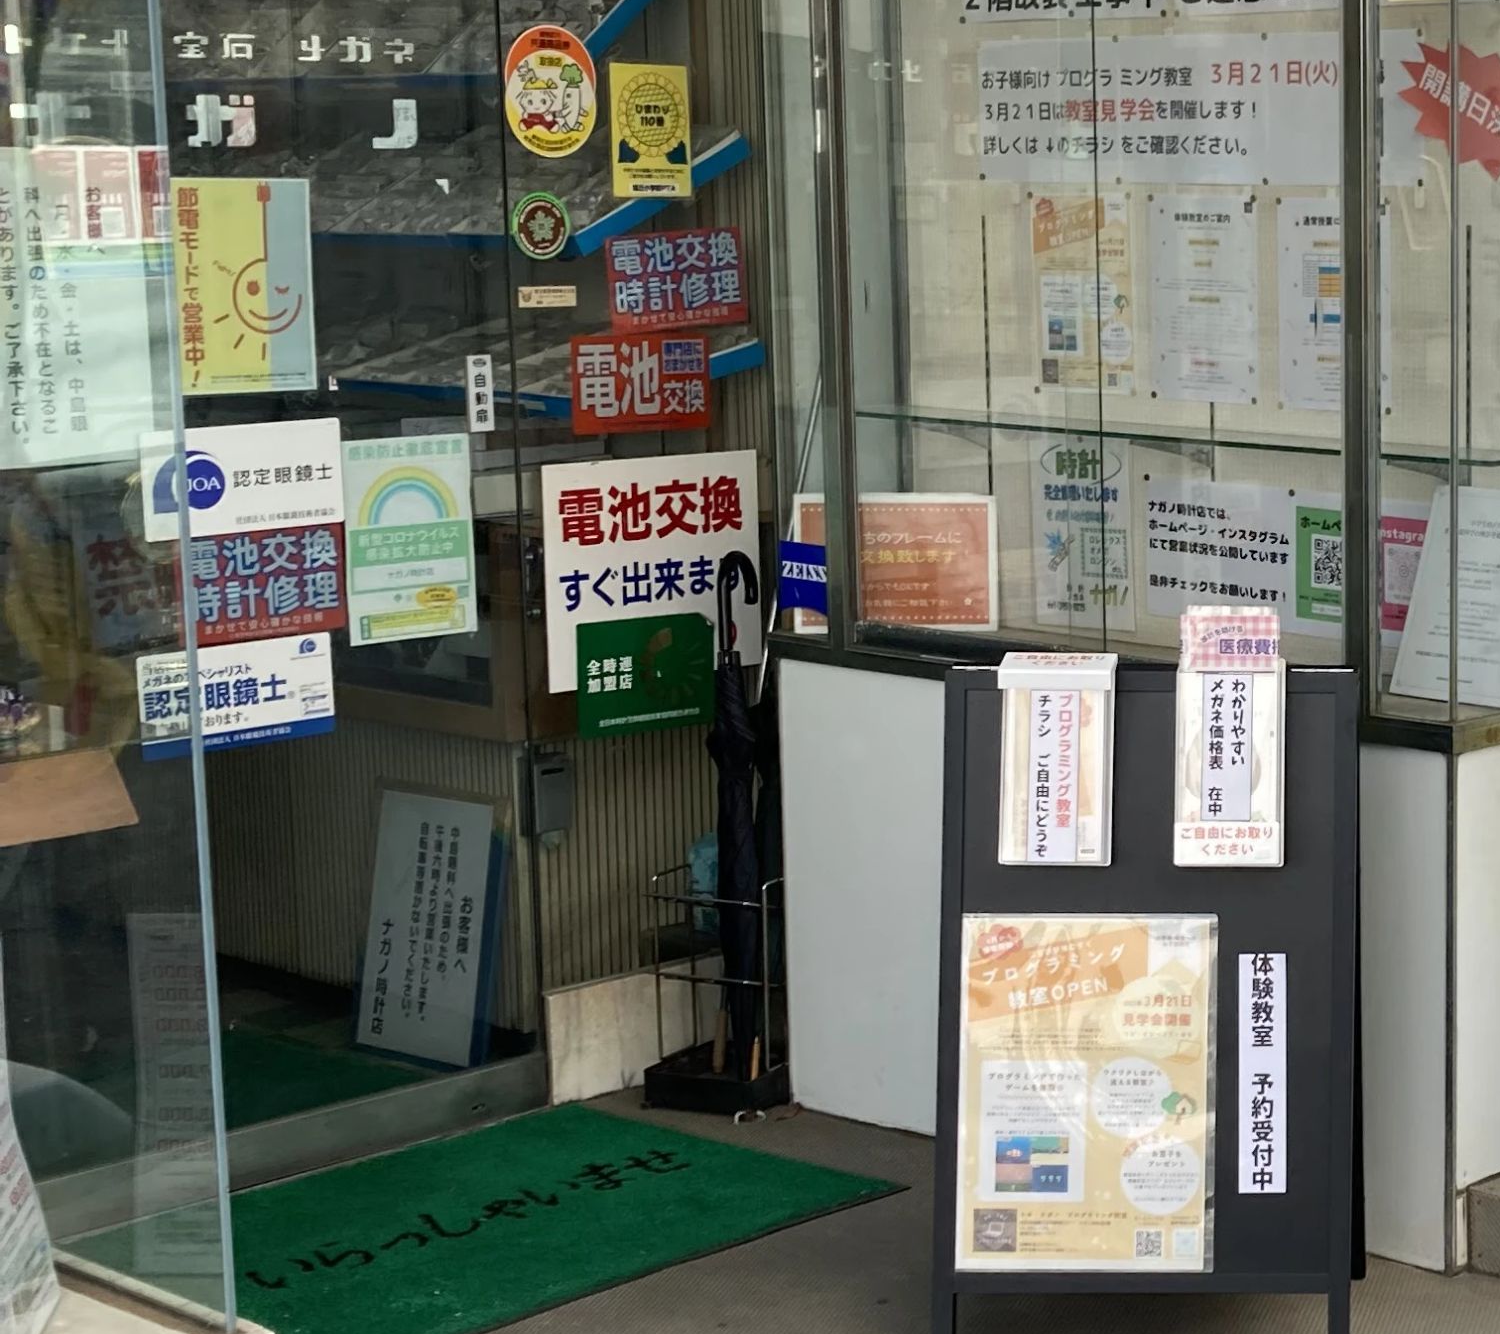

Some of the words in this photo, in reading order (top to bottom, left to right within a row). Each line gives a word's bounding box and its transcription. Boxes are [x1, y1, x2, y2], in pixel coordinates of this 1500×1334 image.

[611, 231, 738, 277] 電池交換
[176, 186, 206, 389] 節電モードで営業中！
[615, 268, 742, 315] 時計修理
[473, 373, 489, 425] 自動扉
[576, 340, 662, 418] 電池
[663, 379, 705, 414] 交換
[233, 463, 334, 489] 認定眼鏡士
[1055, 449, 1100, 481] 時計
[558, 475, 743, 547] 電池交換
[1149, 519, 1290, 547] ホームページ・インスタグラム
[191, 528, 338, 581] 電池交換
[358, 522, 460, 548] 新型コロナウイルス
[1149, 538, 1289, 565] にて営業状況を公開しています
[559, 555, 739, 612] すぐ出来ま
[781, 559, 828, 584] ZEISS
[1149, 573, 1287, 603] 是非チェックをお願いします！
[204, 611, 323, 636] まかせて安心確かな技術
[586, 655, 633, 677] 全時連
[586, 673, 633, 695] 加盟店
[1037, 694, 1052, 739] チラシ
[1208, 678, 1225, 771] メガネ価格表
[1230, 678, 1247, 766] わかりやすい
[1055, 693, 1074, 828] プログラミング教室
[1034, 753, 1051, 858] ご自由にどうぞ
[1208, 786, 1224, 818] 在中
[1181, 825, 1273, 841] ご自由にお取り
[1201, 843, 1254, 857] ください
[453, 895, 475, 976] お客様へ
[370, 918, 395, 1035] ナガノ時計店
[981, 942, 1127, 987] プログラミング
[1250, 953, 1275, 1047] 体験教室
[1250, 1073, 1275, 1192] 予約受付中
